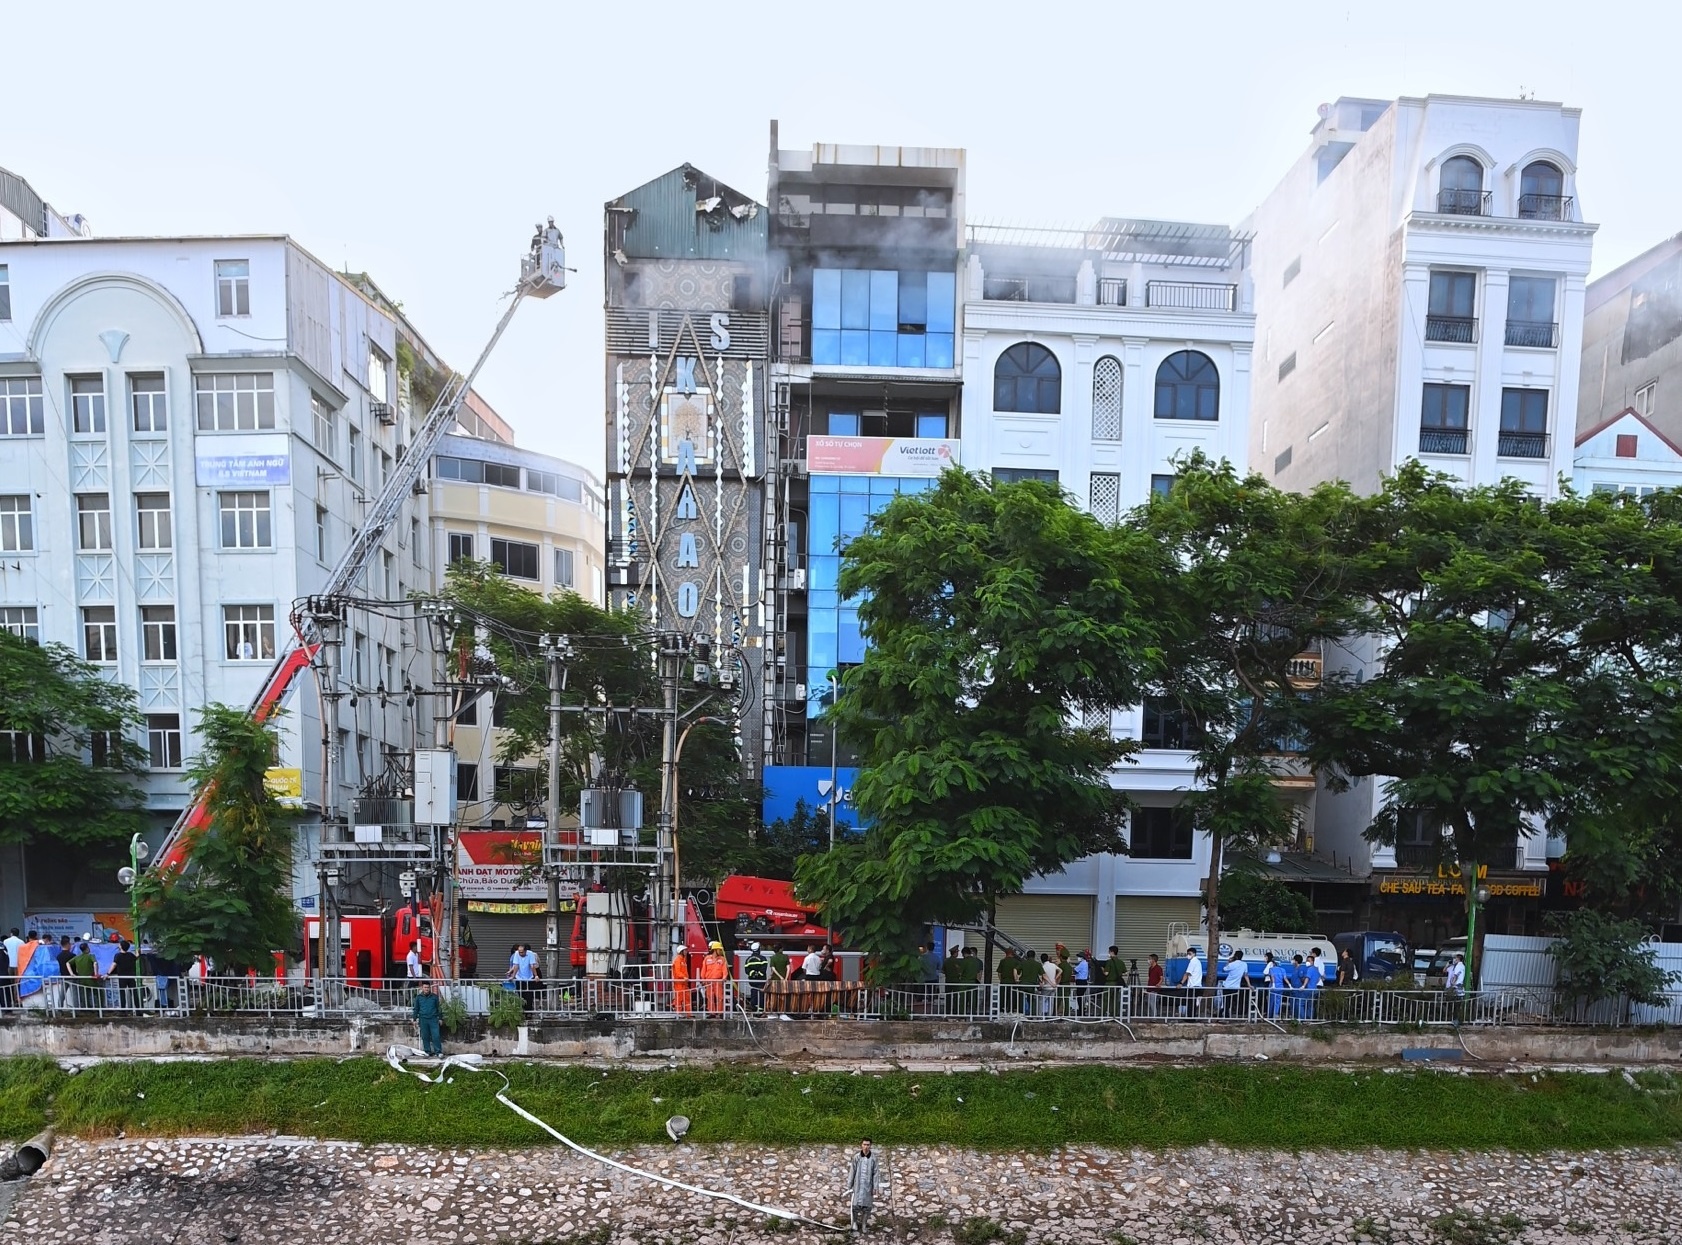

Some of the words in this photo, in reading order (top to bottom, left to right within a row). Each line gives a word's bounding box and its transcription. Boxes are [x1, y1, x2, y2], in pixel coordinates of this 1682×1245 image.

[900, 446, 936, 455] Vietlott
[201, 460, 226, 468] TRUNG
[229, 459, 246, 468] TÂM
[1438, 863, 1488, 880] LOM
[1428, 883, 1446, 895] TEA
[1505, 884, 1541, 896] COFFEE
